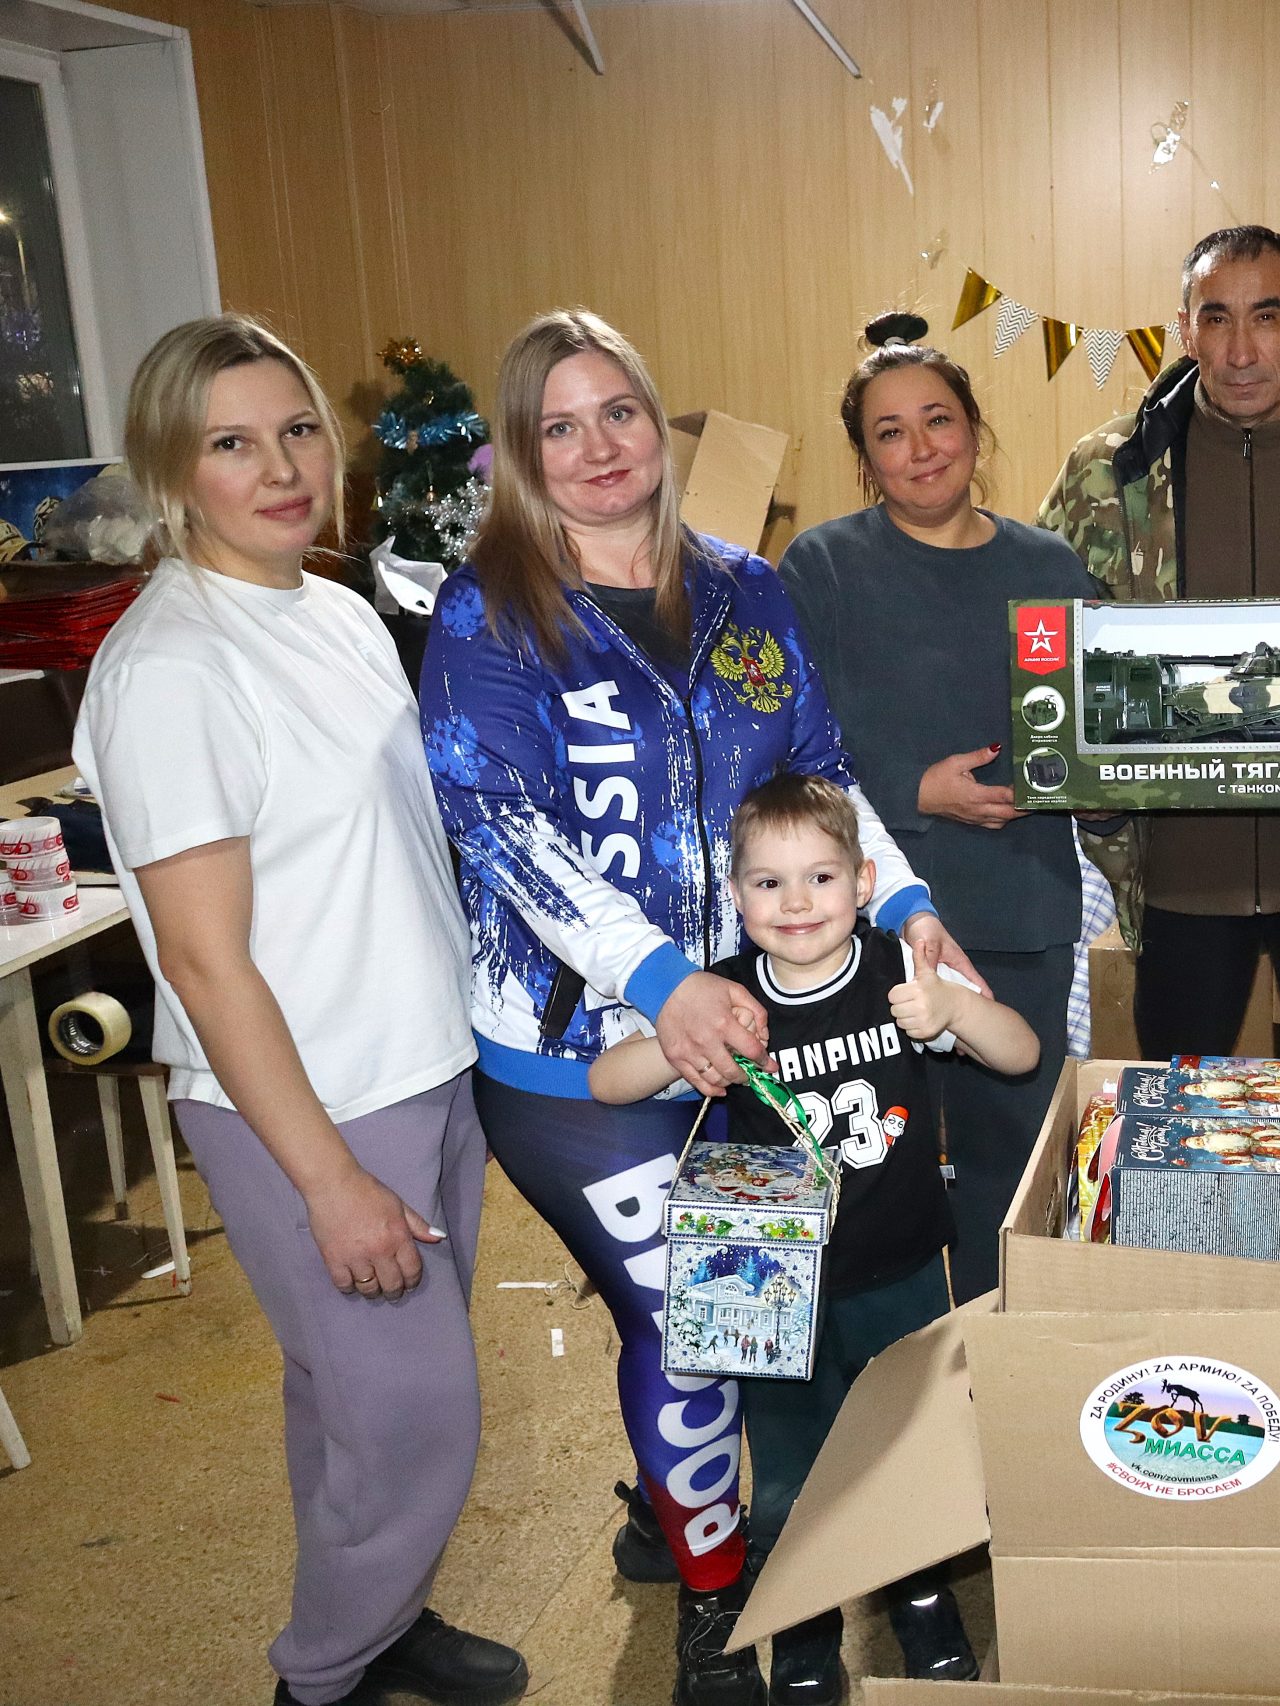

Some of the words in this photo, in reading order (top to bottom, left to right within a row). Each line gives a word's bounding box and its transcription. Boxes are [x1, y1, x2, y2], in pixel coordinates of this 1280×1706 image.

[561, 680, 642, 879] SSIA
[1100, 759, 1226, 781] ВОЕННЫЙ
[784, 1078, 888, 1170] 23
[582, 1153, 741, 1557] РОСЯ
[1098, 1369, 1149, 1406] РОДИНУ!
[1178, 1362, 1243, 1383] АРМИЮ!
[1256, 1395, 1280, 1443] ПОБЕДУ!
[1114, 1402, 1233, 1444] ZOV
[1131, 1462, 1219, 1483] vk.com/zovmiassa
[1144, 1438, 1246, 1465] МИАССА
[1106, 1461, 1153, 1491] #СВОИХ
[1155, 1485, 1174, 1496] НЕ
[1177, 1478, 1242, 1496] БРОСАЕМ
